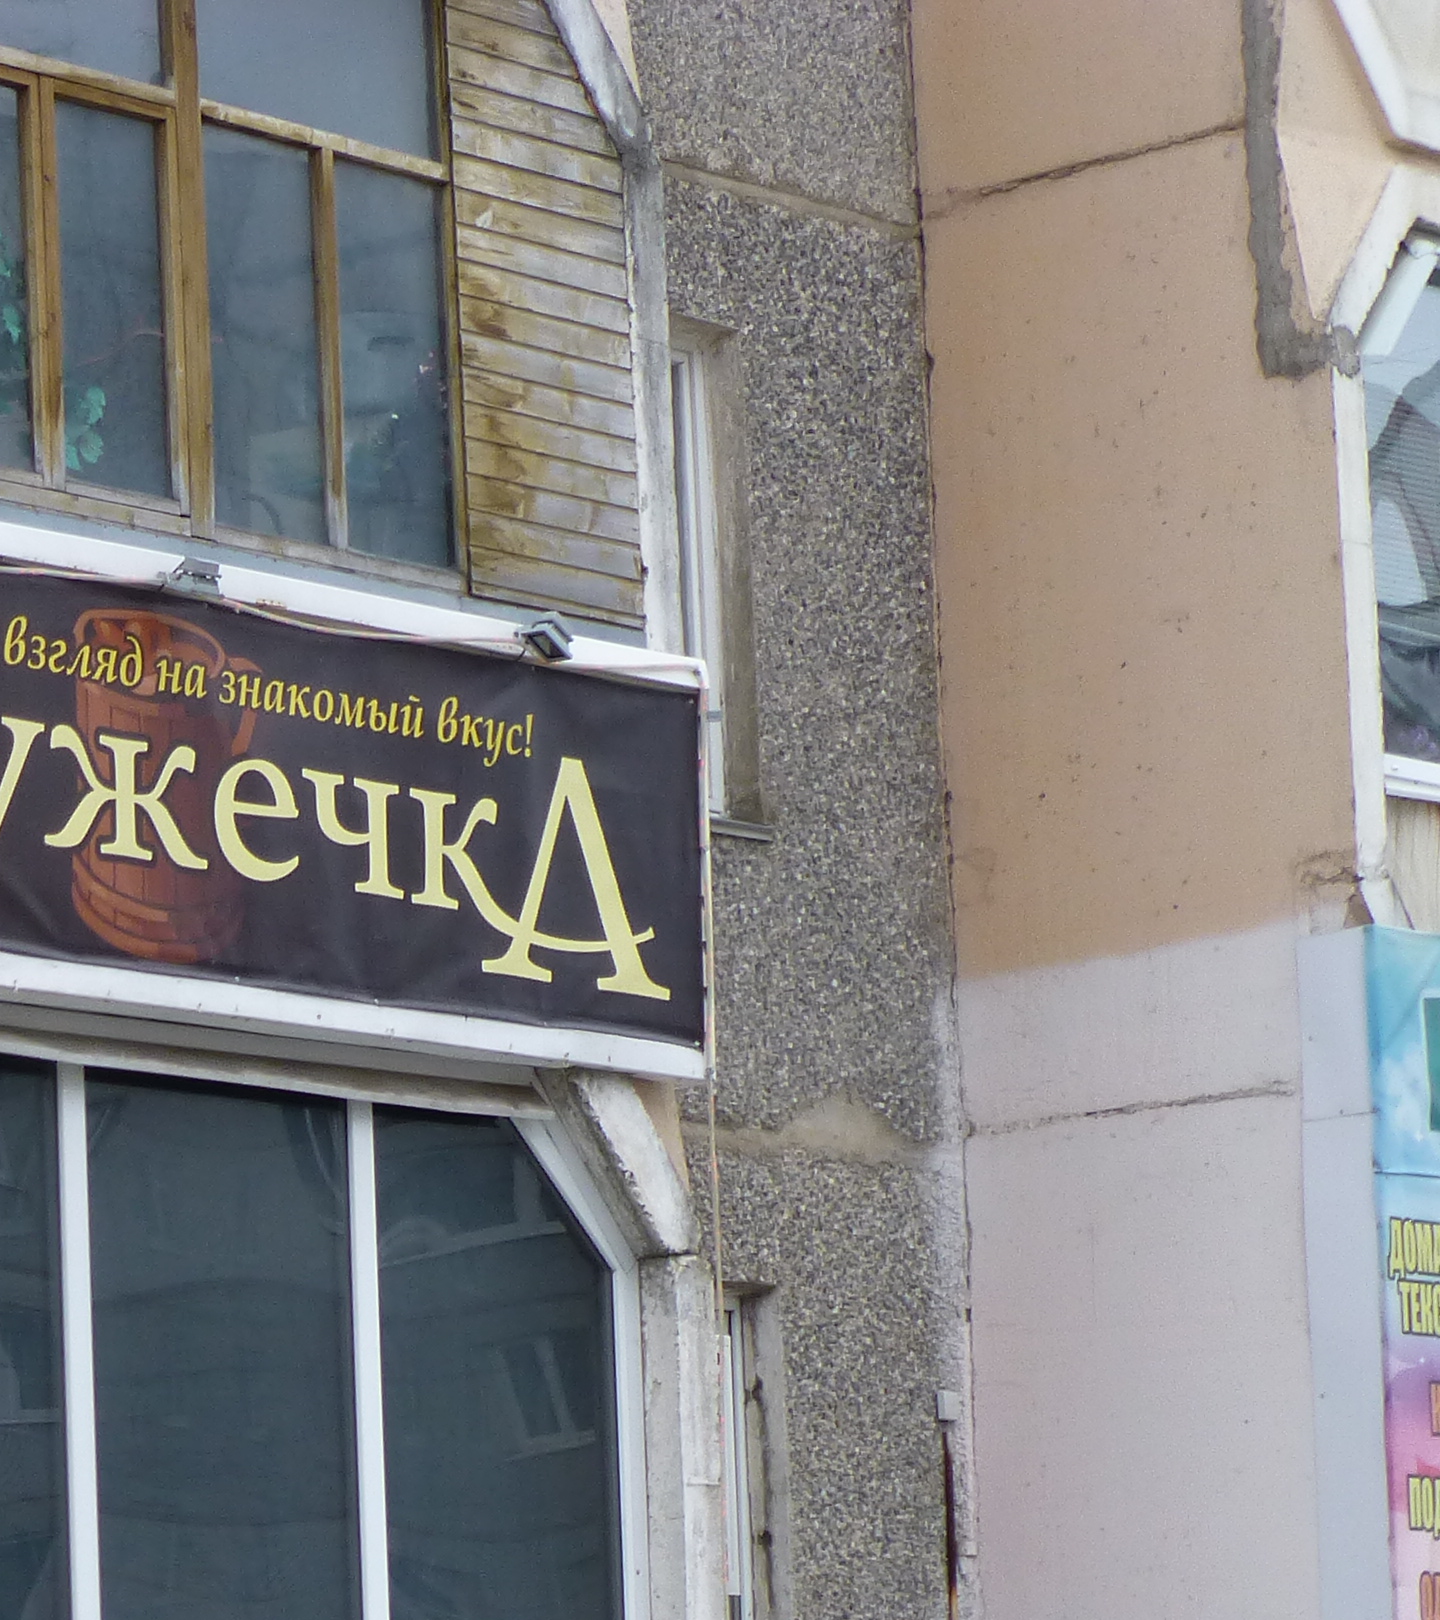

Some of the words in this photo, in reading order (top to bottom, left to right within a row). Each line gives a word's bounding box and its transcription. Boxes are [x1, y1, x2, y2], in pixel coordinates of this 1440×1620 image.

[4, 615, 143, 688] взгляд
[156, 658, 207, 698] на
[219, 670, 423, 739] знакомый
[437, 697, 534, 768] вкус!
